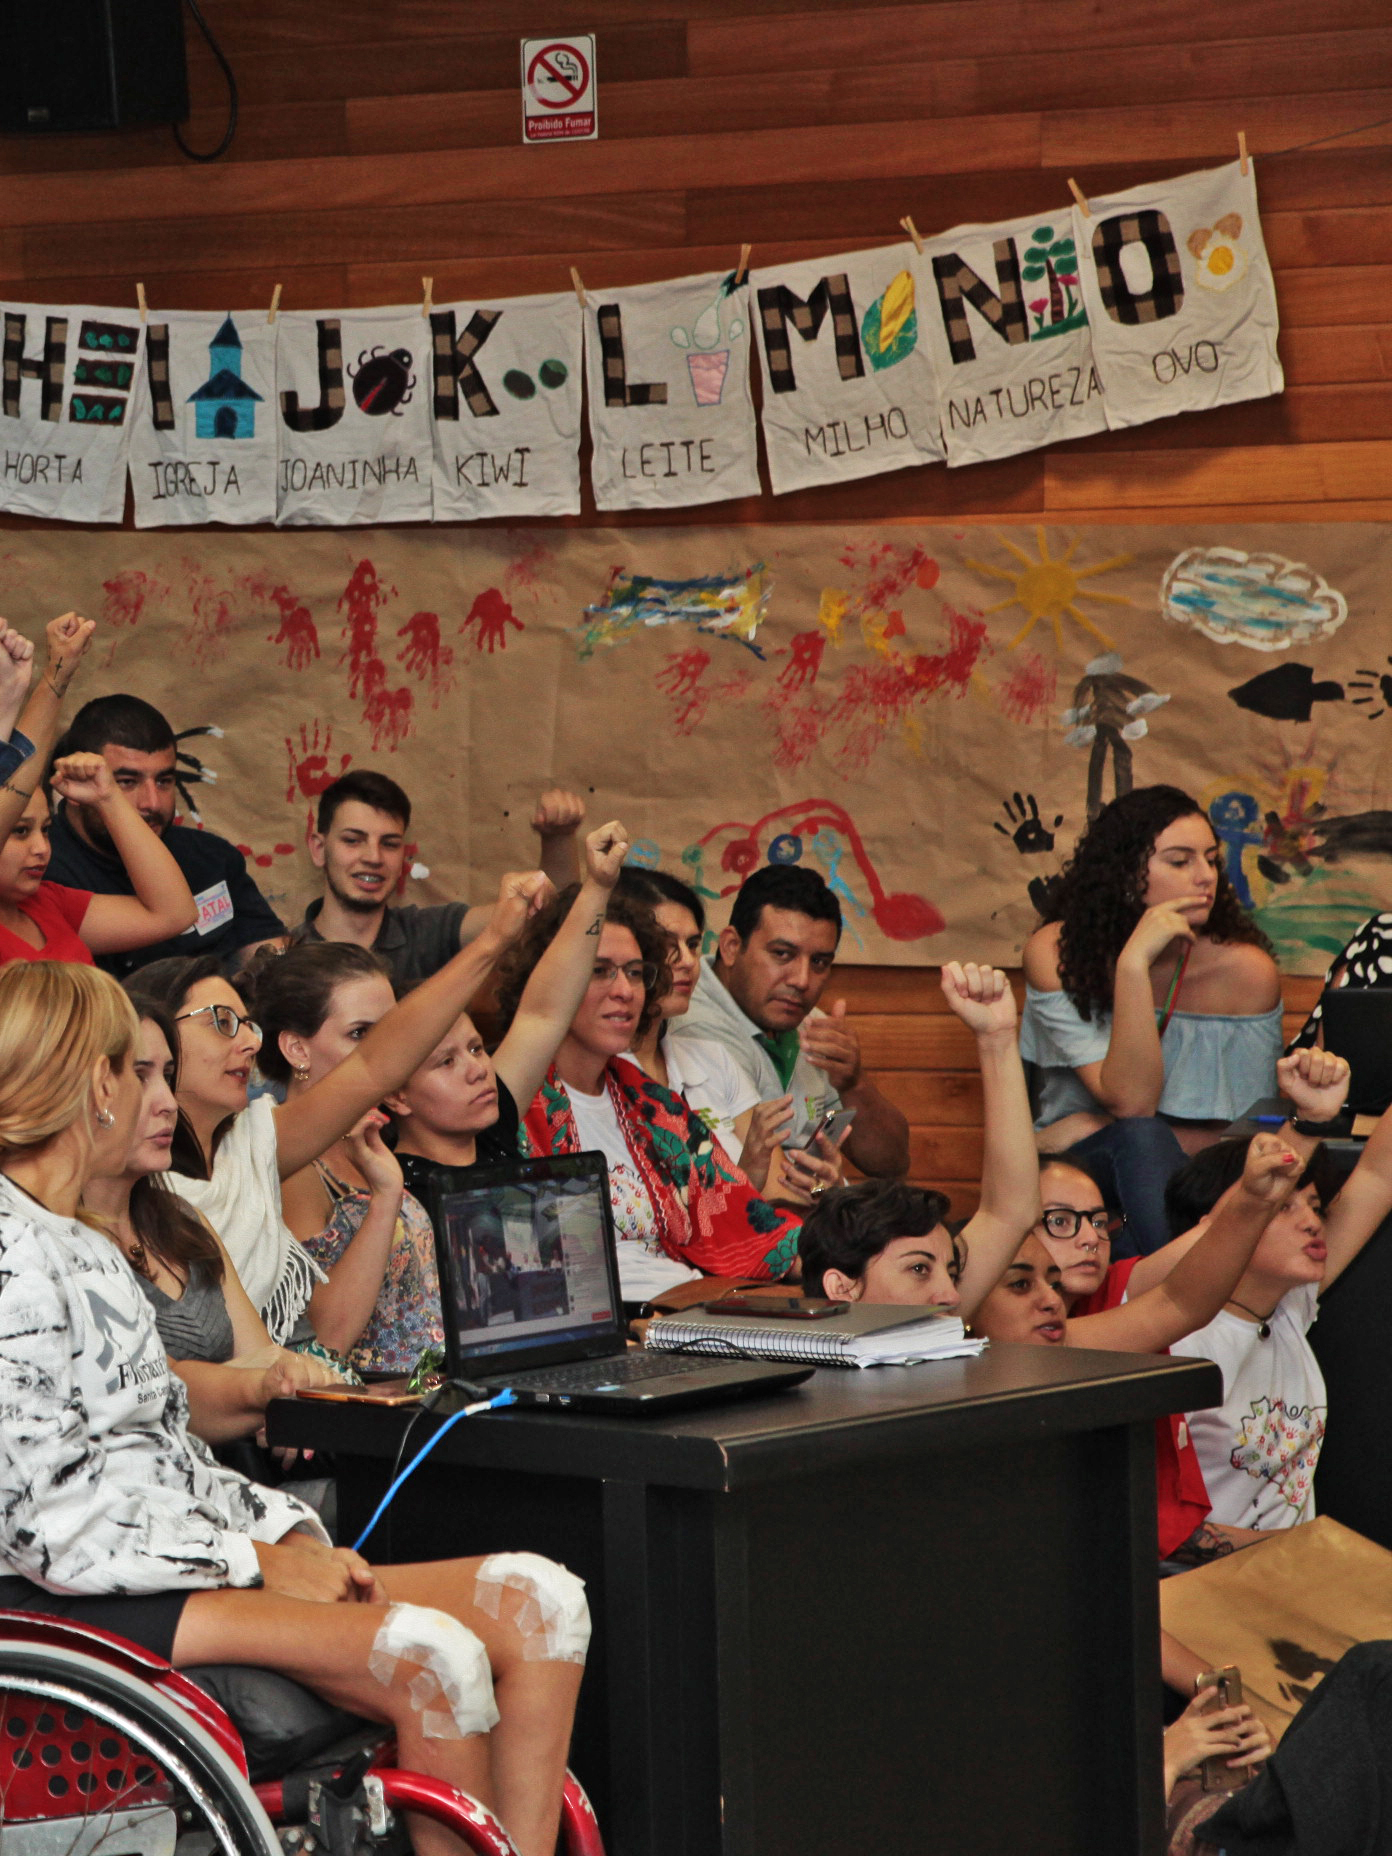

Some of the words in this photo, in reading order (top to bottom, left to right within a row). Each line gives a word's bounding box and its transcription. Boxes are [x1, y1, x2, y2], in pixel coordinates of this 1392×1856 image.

[528, 119, 562, 131] Proibido
[565, 117, 592, 128] Fumar
[1092, 209, 1184, 325] O
[932, 237, 1029, 365] N
[597, 303, 667, 407] L
[757, 273, 865, 393] M
[1151, 340, 1220, 384] OVO
[3, 313, 68, 422] H
[146, 323, 175, 430] I
[280, 319, 345, 432] J
[429, 310, 503, 421] K
[948, 366, 1104, 429] NATUREZA
[621, 437, 715, 479] LEITE
[805, 406, 910, 457] MILHO
[5, 451, 83, 484] HORTA
[148, 460, 241, 500] IGREJA
[280, 454, 419, 493] JOANINHA
[456, 446, 531, 488] KIWI
